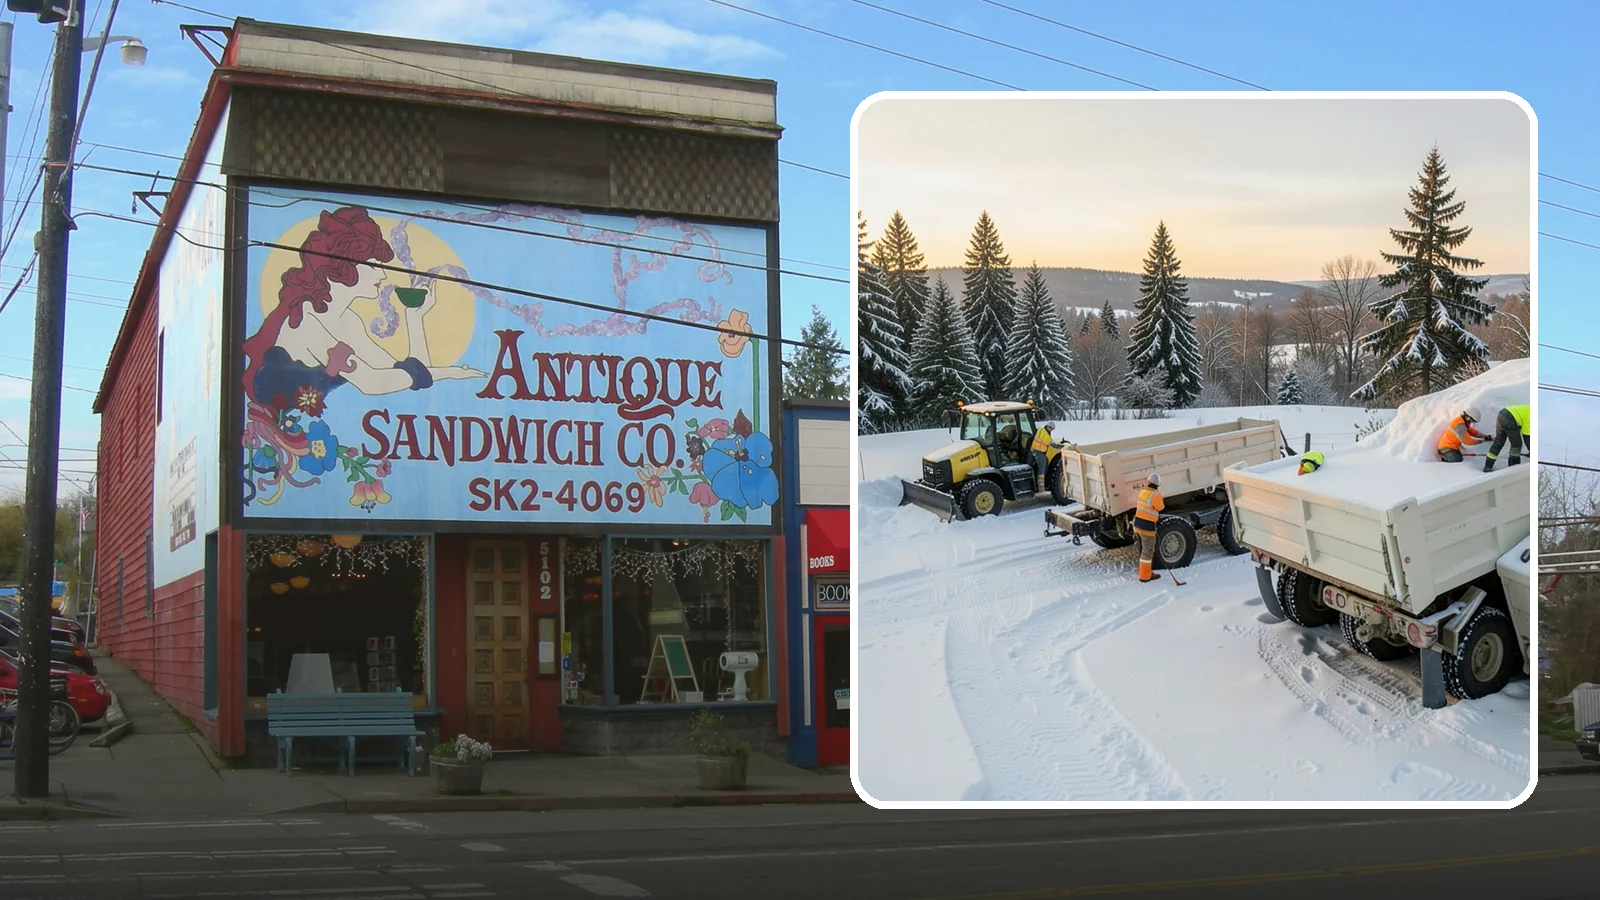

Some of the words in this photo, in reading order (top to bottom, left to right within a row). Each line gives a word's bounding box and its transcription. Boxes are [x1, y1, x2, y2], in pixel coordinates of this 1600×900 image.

[475, 328, 723, 421] ANTIQUE
[360, 408, 605, 468] SANDWICH
[616, 421, 685, 469] CO.
[468, 476, 646, 514] SK2-4069
[539, 541, 552, 600] 5102
[809, 555, 835, 569] BOOKS
